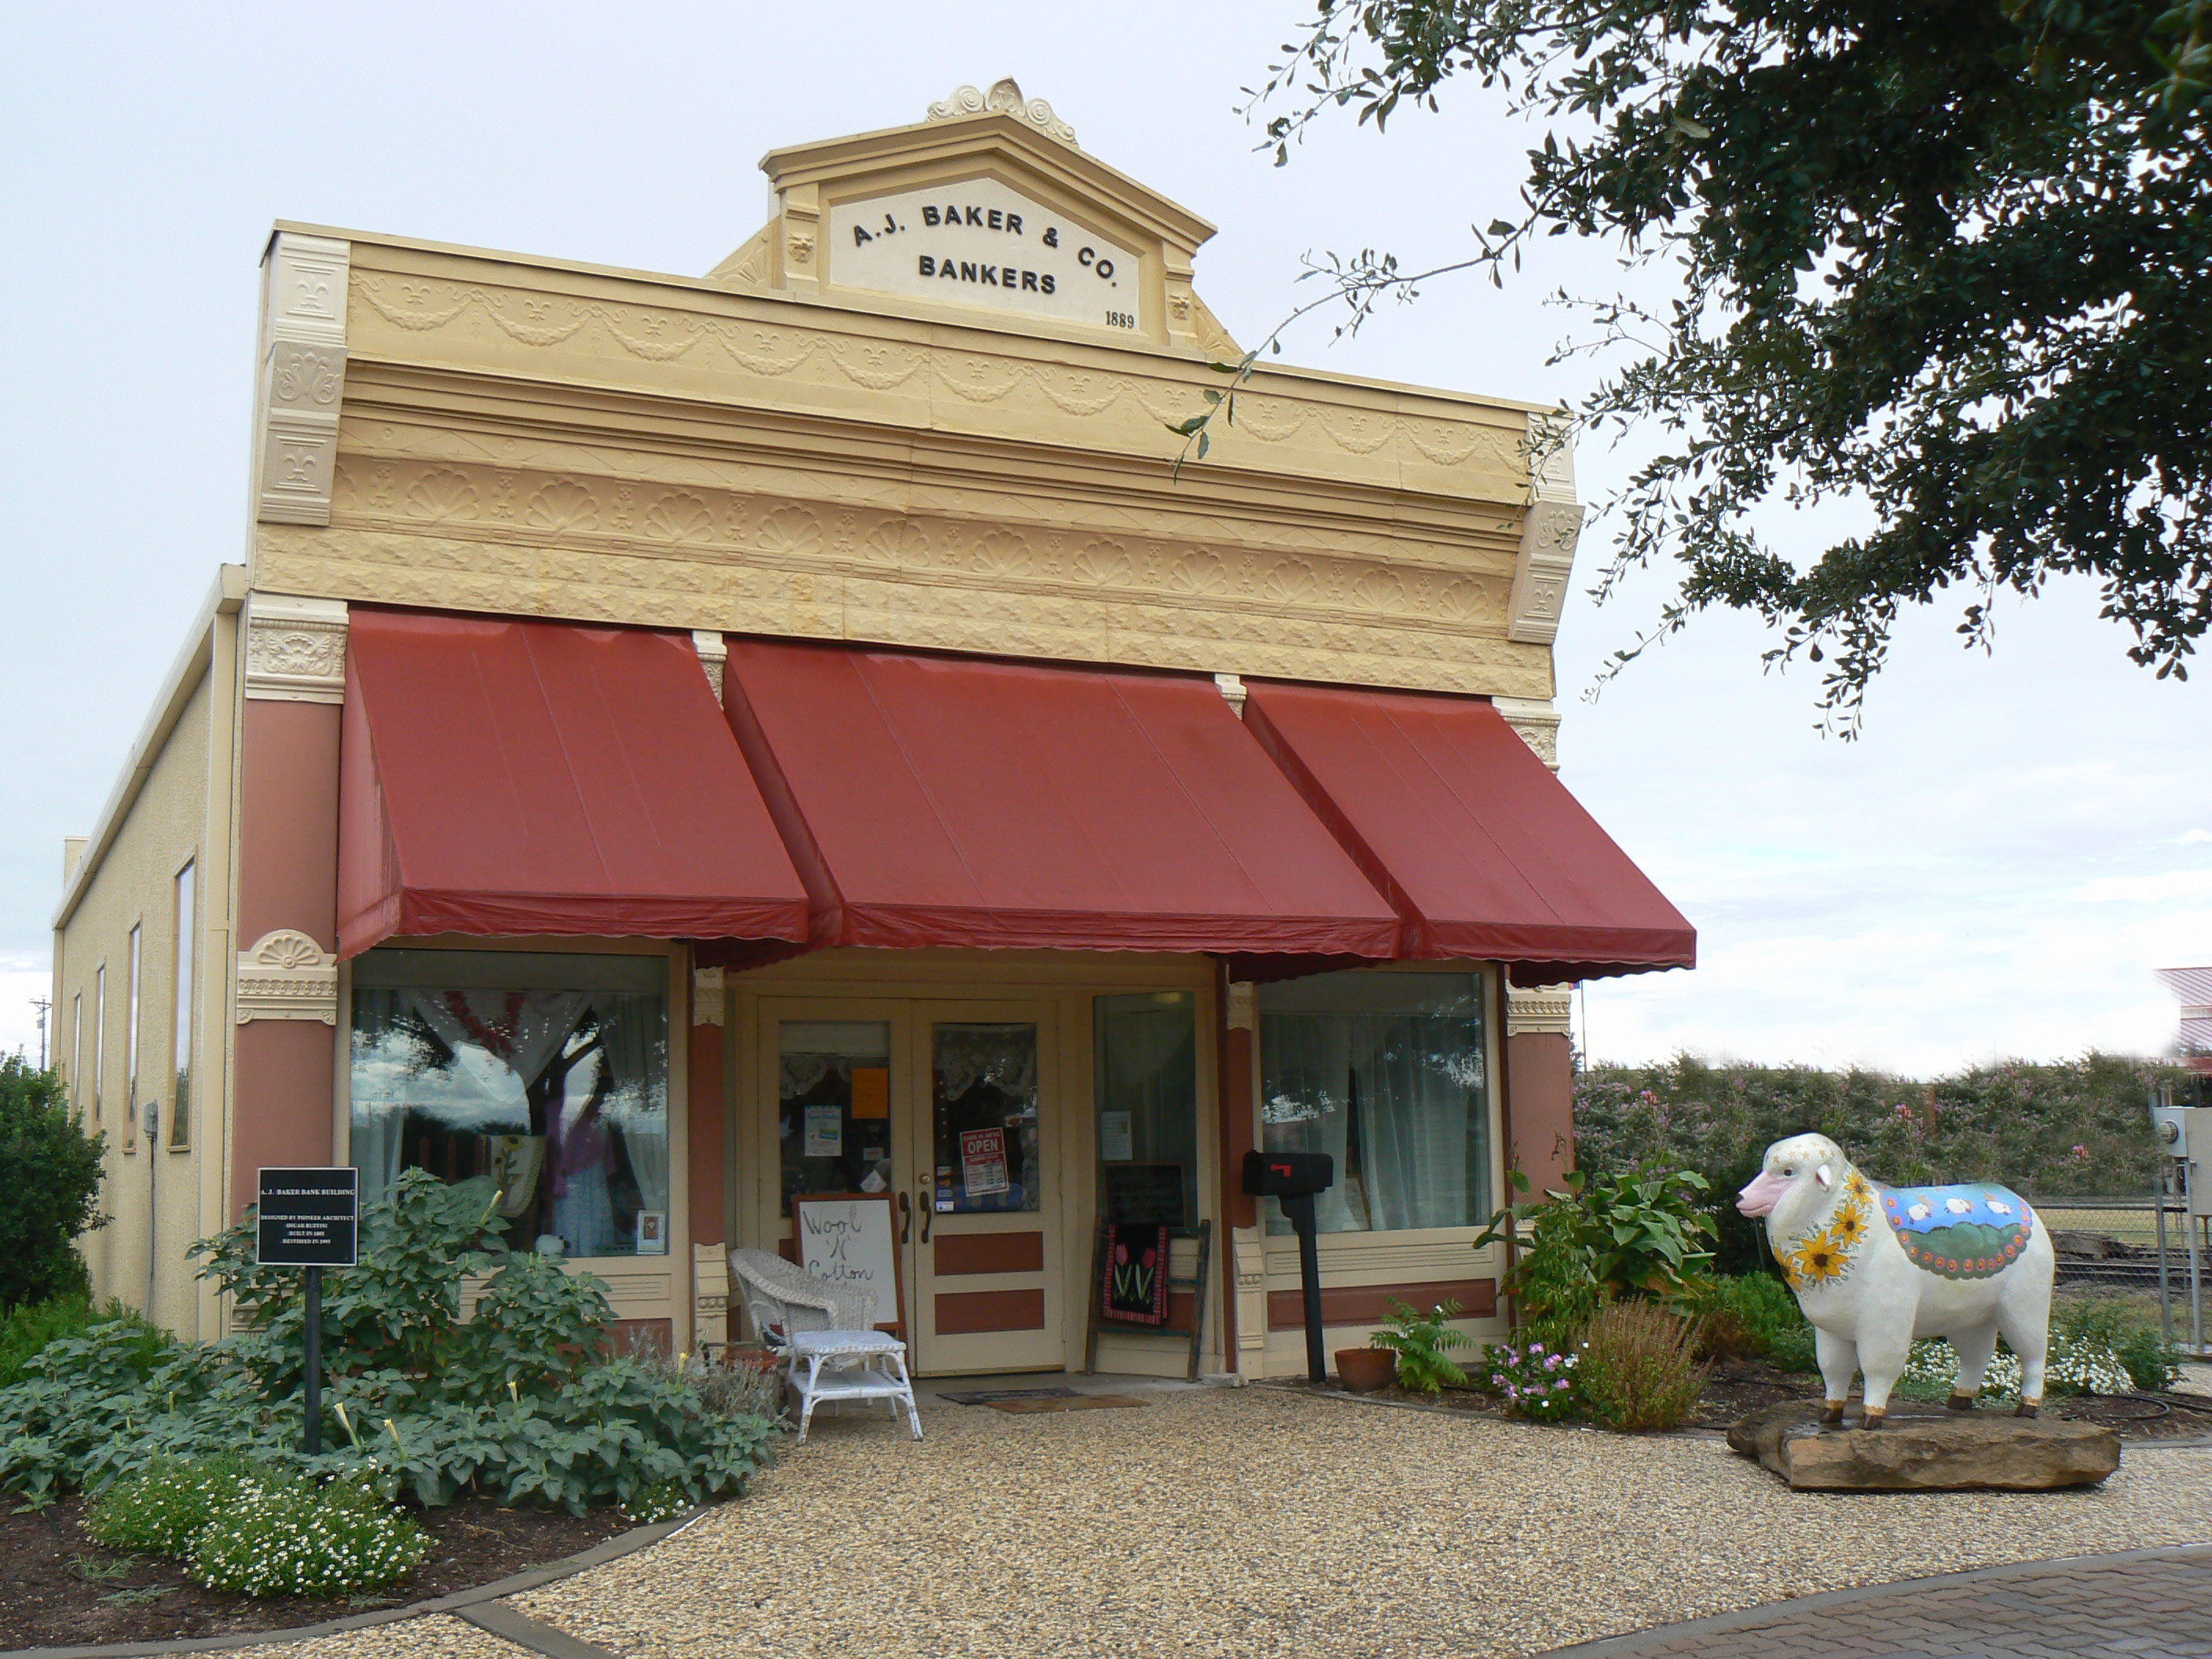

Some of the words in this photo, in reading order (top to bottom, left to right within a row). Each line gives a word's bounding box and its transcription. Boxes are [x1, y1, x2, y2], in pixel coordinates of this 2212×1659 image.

[854, 213, 906, 247] A.J.
[922, 205, 1024, 235] BAKER
[1042, 226, 1059, 248] &
[1078, 247, 1118, 287] CO.
[919, 255, 1057, 295] BANKERS
[1106, 310, 1134, 329] 1889
[967, 1137, 999, 1155] OPEN
[802, 1204, 862, 1235] Wool
[809, 1259, 874, 1280] Cotton
